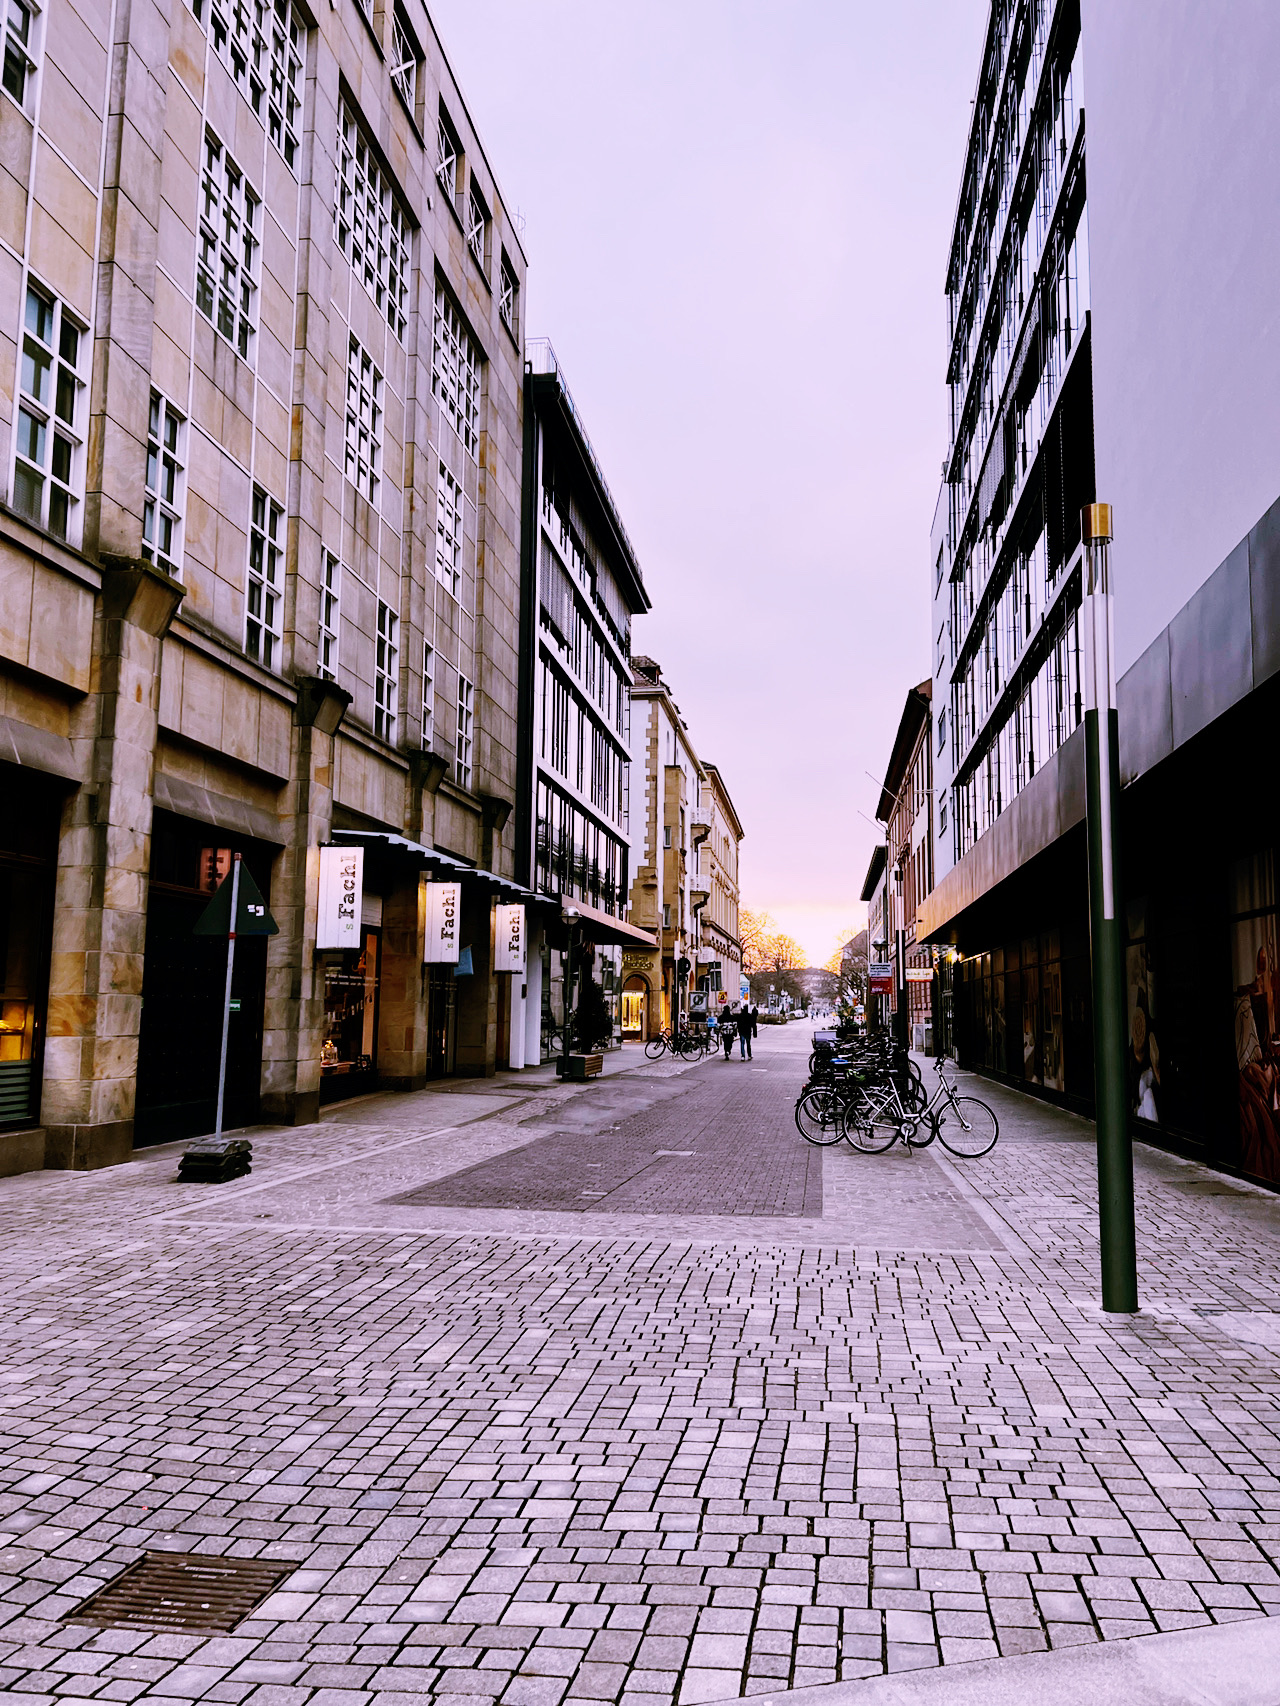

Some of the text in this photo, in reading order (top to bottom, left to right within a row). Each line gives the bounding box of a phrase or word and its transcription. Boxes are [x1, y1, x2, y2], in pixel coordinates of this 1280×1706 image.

[338, 855, 356, 919] Fachl
[441, 889, 455, 940] Fachl
[509, 909, 520, 952] Fachl
